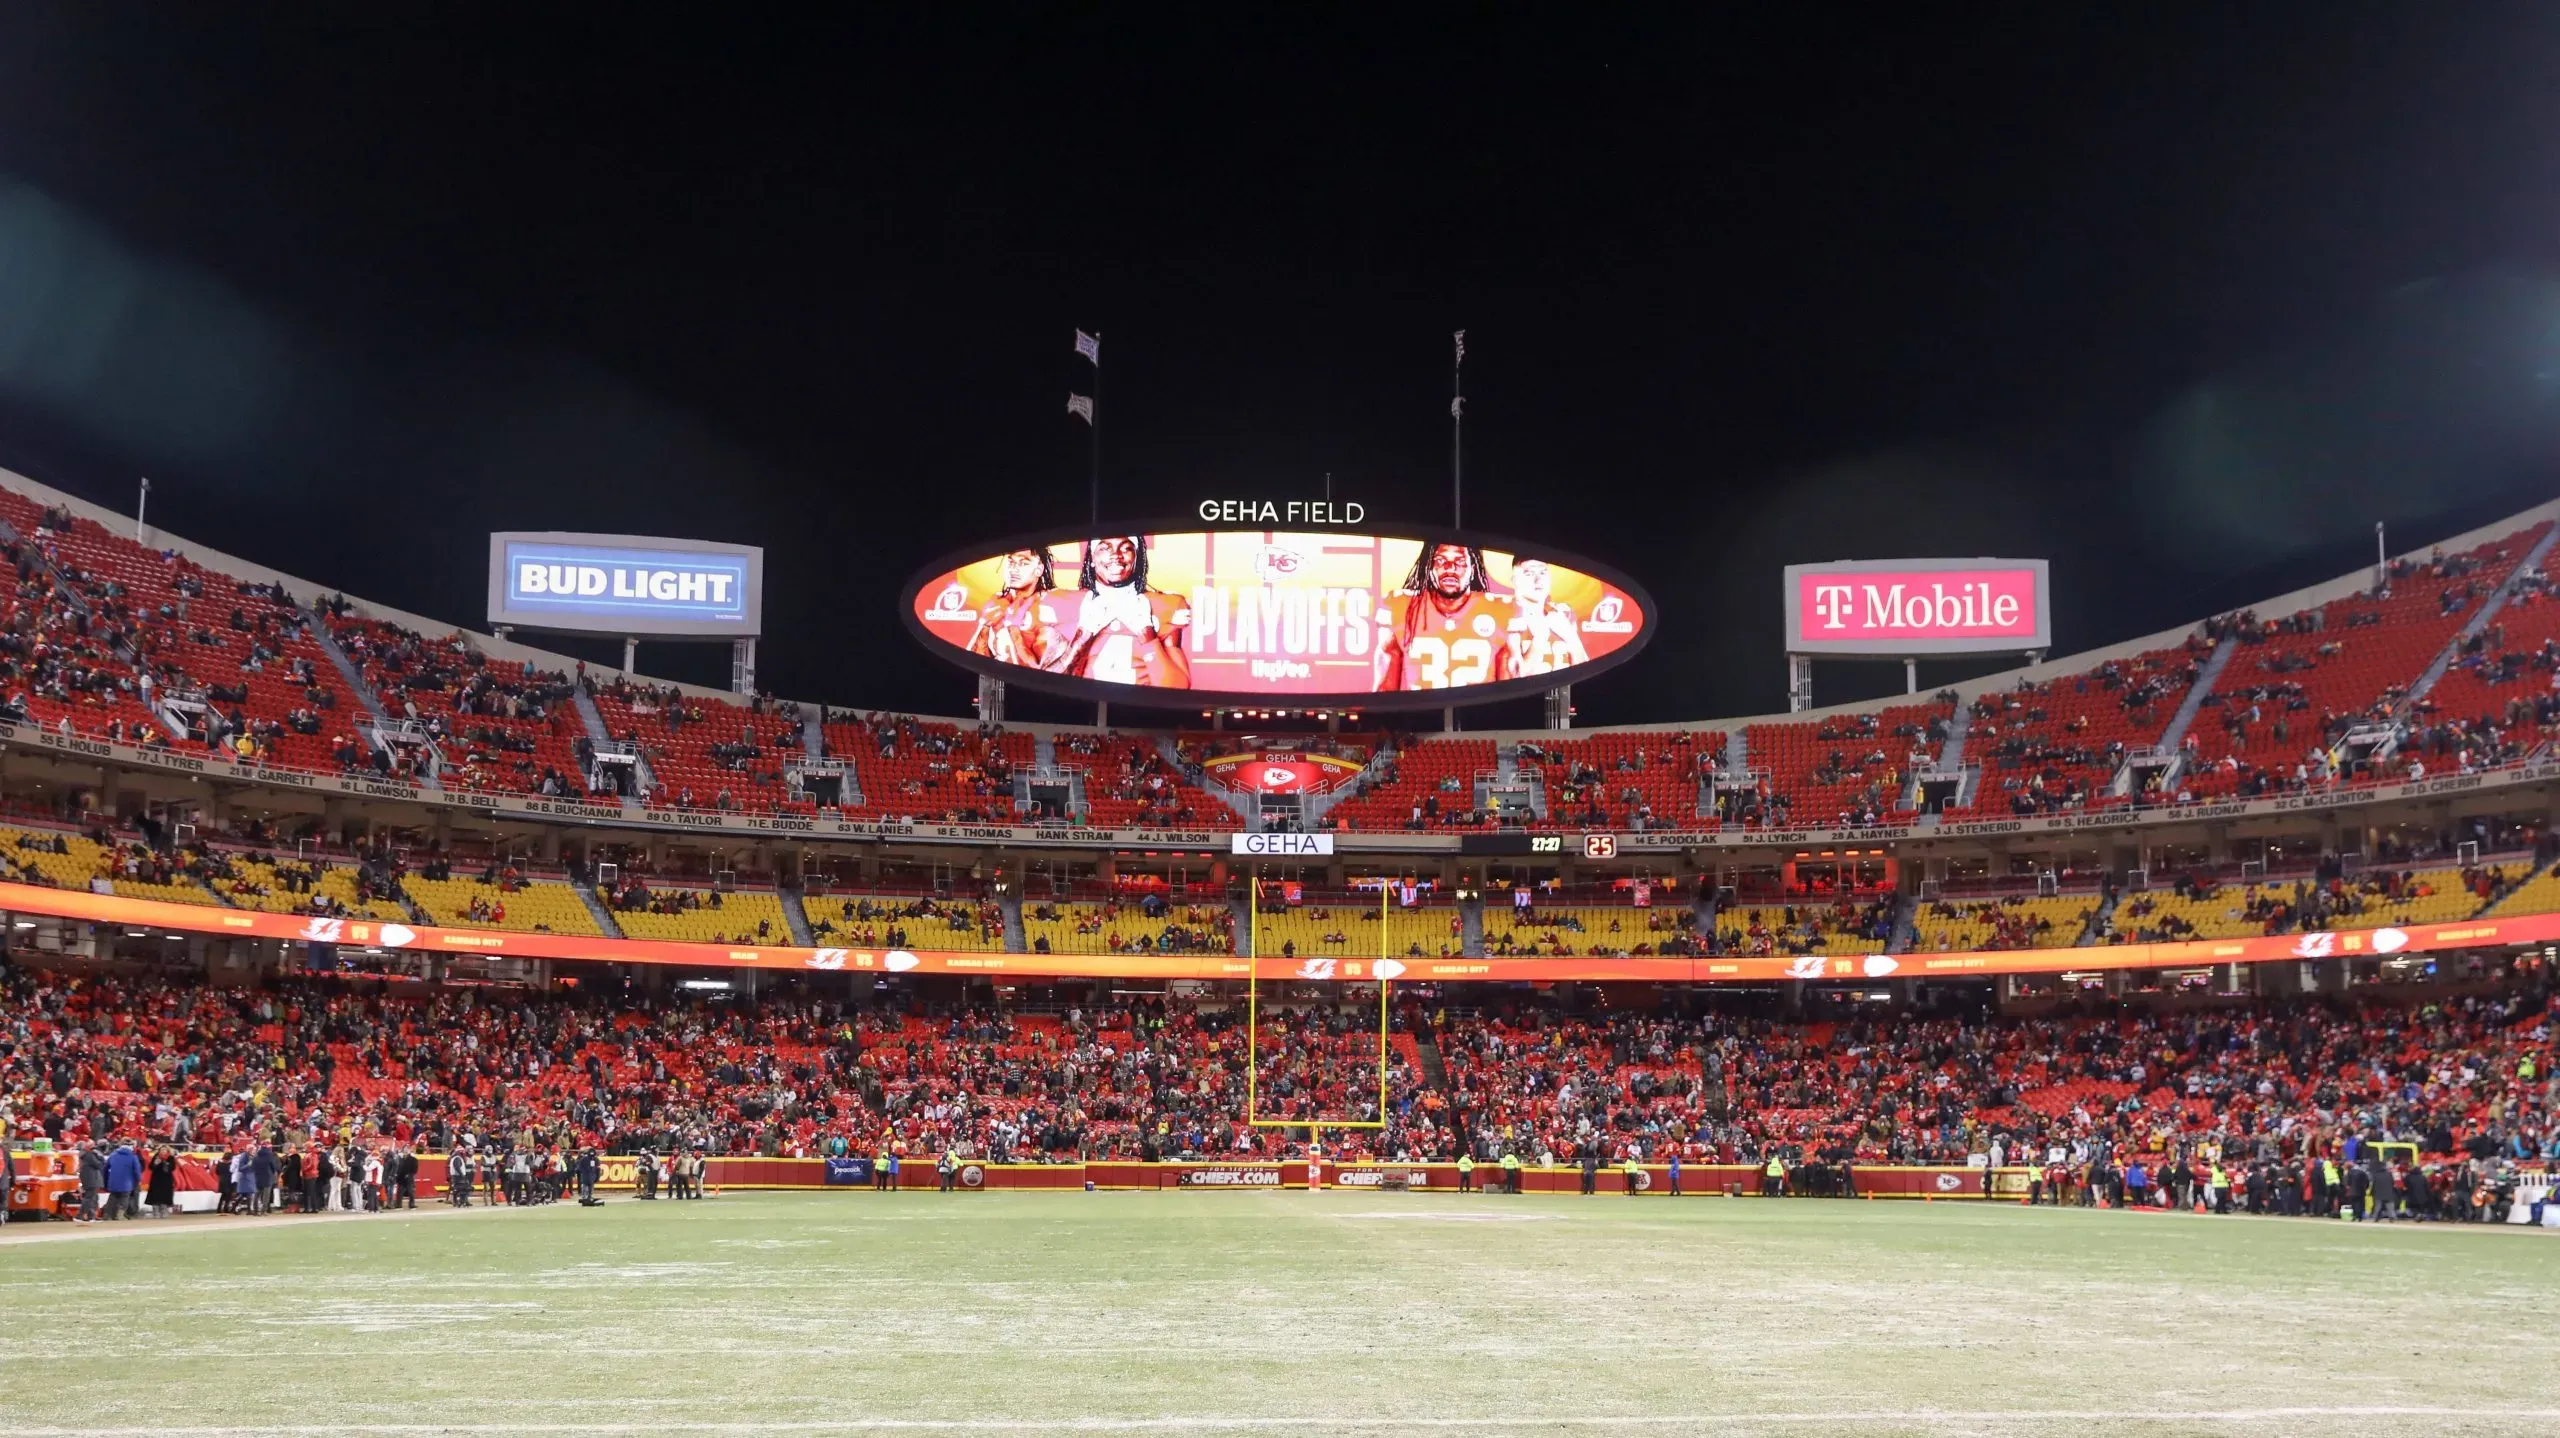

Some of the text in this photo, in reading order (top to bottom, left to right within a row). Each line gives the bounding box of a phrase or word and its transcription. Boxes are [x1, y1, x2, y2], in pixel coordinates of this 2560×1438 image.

[1199, 500, 1364, 523] GEHA FIELD
[520, 564, 607, 596] BUD
[1862, 583, 2019, 629] Mobile
[1191, 586, 1370, 655] PLAYOFFS
[1409, 637, 1492, 690] 32
[40, 734, 54, 745] 55
[69, 738, 111, 756] HOLUB
[136, 751, 148, 761] 77
[164, 754, 204, 771] TYRER
[1266, 754, 1296, 763] GEHA
[1216, 763, 1237, 773] GEHA
[1323, 763, 1341, 774] GEHA
[229, 766, 240, 775] 21
[258, 769, 315, 787] GARRETT
[340, 781, 351, 790] 16
[366, 783, 418, 800] DAWSON
[2430, 776, 2482, 792] CHERRY
[457, 794, 469, 804] B.
[471, 796, 499, 808] BELL
[541, 802, 552, 813] B.
[555, 803, 622, 819] BUCHANAN
[646, 812, 722, 826] 89 O. TAYLOR
[747, 819, 814, 831] 71 E. BUDDE
[2077, 813, 2141, 827] HEADRICK
[837, 823, 913, 835] 63 W. LANIER
[937, 827, 1012, 838] 18 E. THOMAS
[1831, 828, 1909, 840] 28 A. HAYNES
[1934, 827, 1940, 835] 3
[1956, 821, 2021, 834] STENERUD
[1036, 831, 1113, 841] HANK STRAM
[1137, 833, 1210, 843] 44 J. WILSON
[1635, 835, 1717, 844] 14 E. PODOLAK
[1743, 833, 1807, 843] 51 J. LYNCH
[1246, 834, 1318, 853] GEHA
[1588, 838, 1612, 855] 25
[856, 953, 873, 966] VS
[1835, 961, 1852, 973] VS
[834, 1165, 861, 1175] peacock
[1191, 1172, 1279, 1185] CHIEFS.COM
[14, 1190, 28, 1204] G
